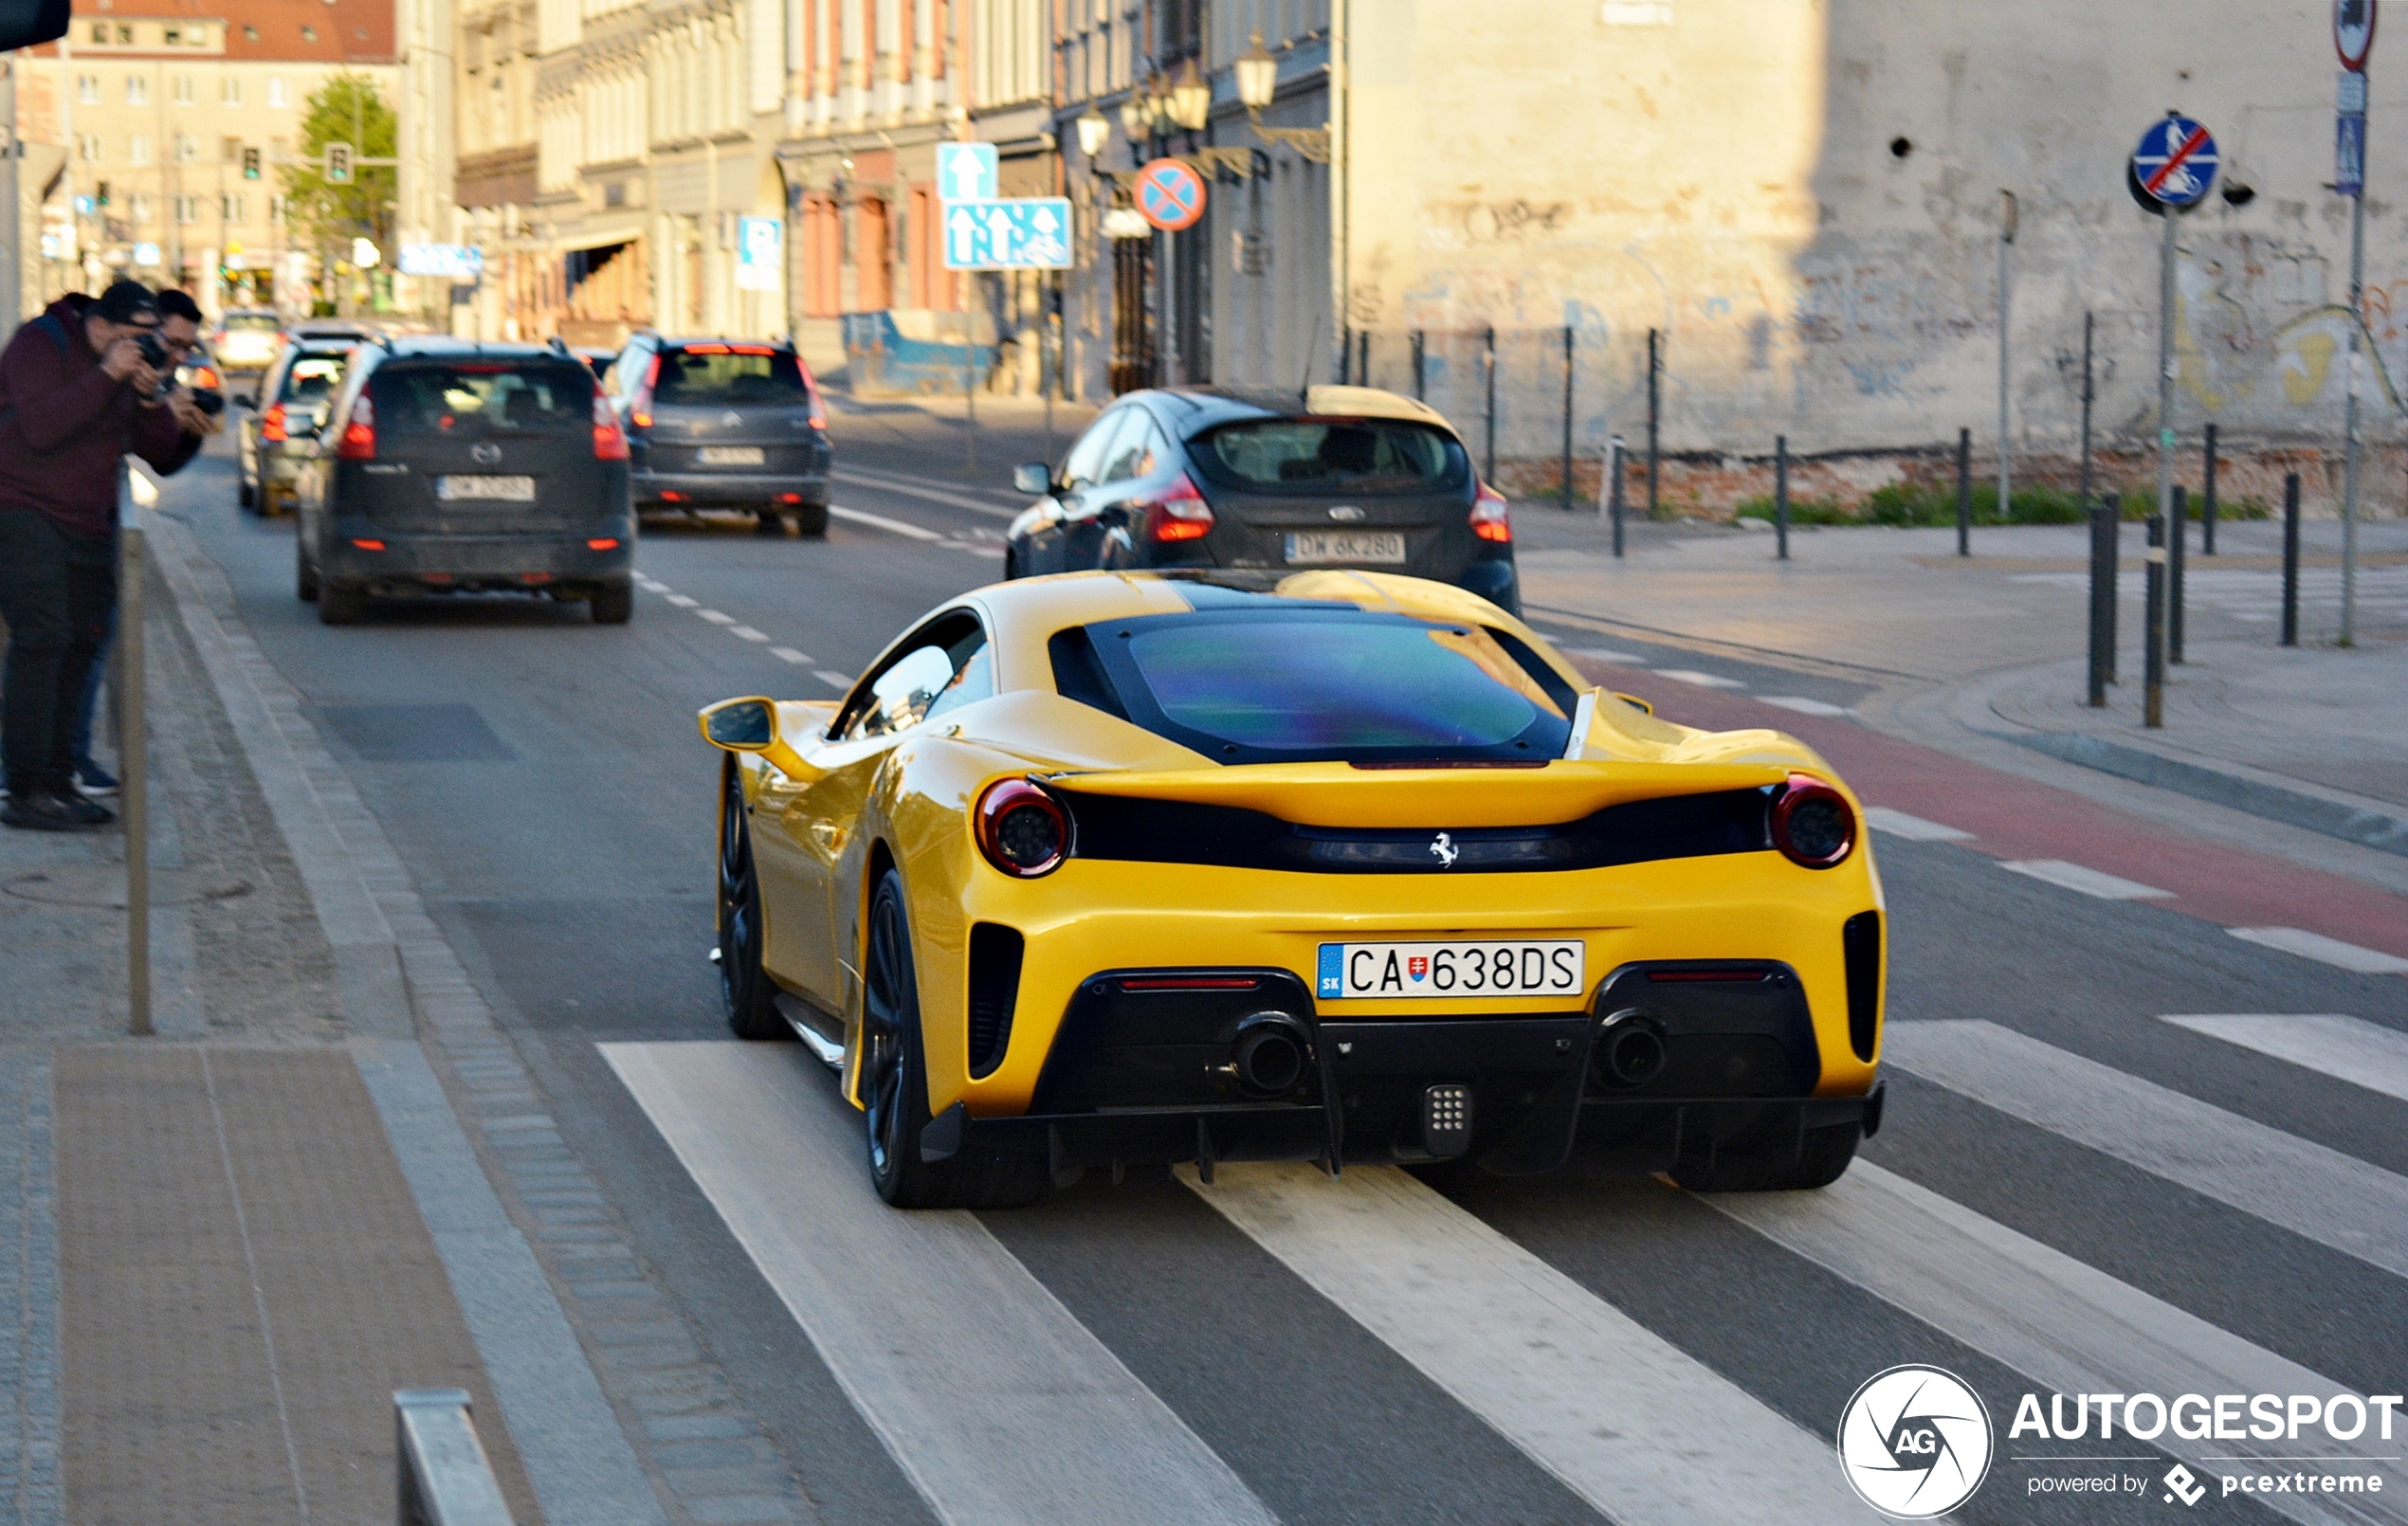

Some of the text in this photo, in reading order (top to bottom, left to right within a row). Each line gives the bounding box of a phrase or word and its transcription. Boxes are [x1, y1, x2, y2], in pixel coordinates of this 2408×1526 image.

[1350, 947, 1576, 991] CA 638DS
[1322, 977, 1340, 990] SK
